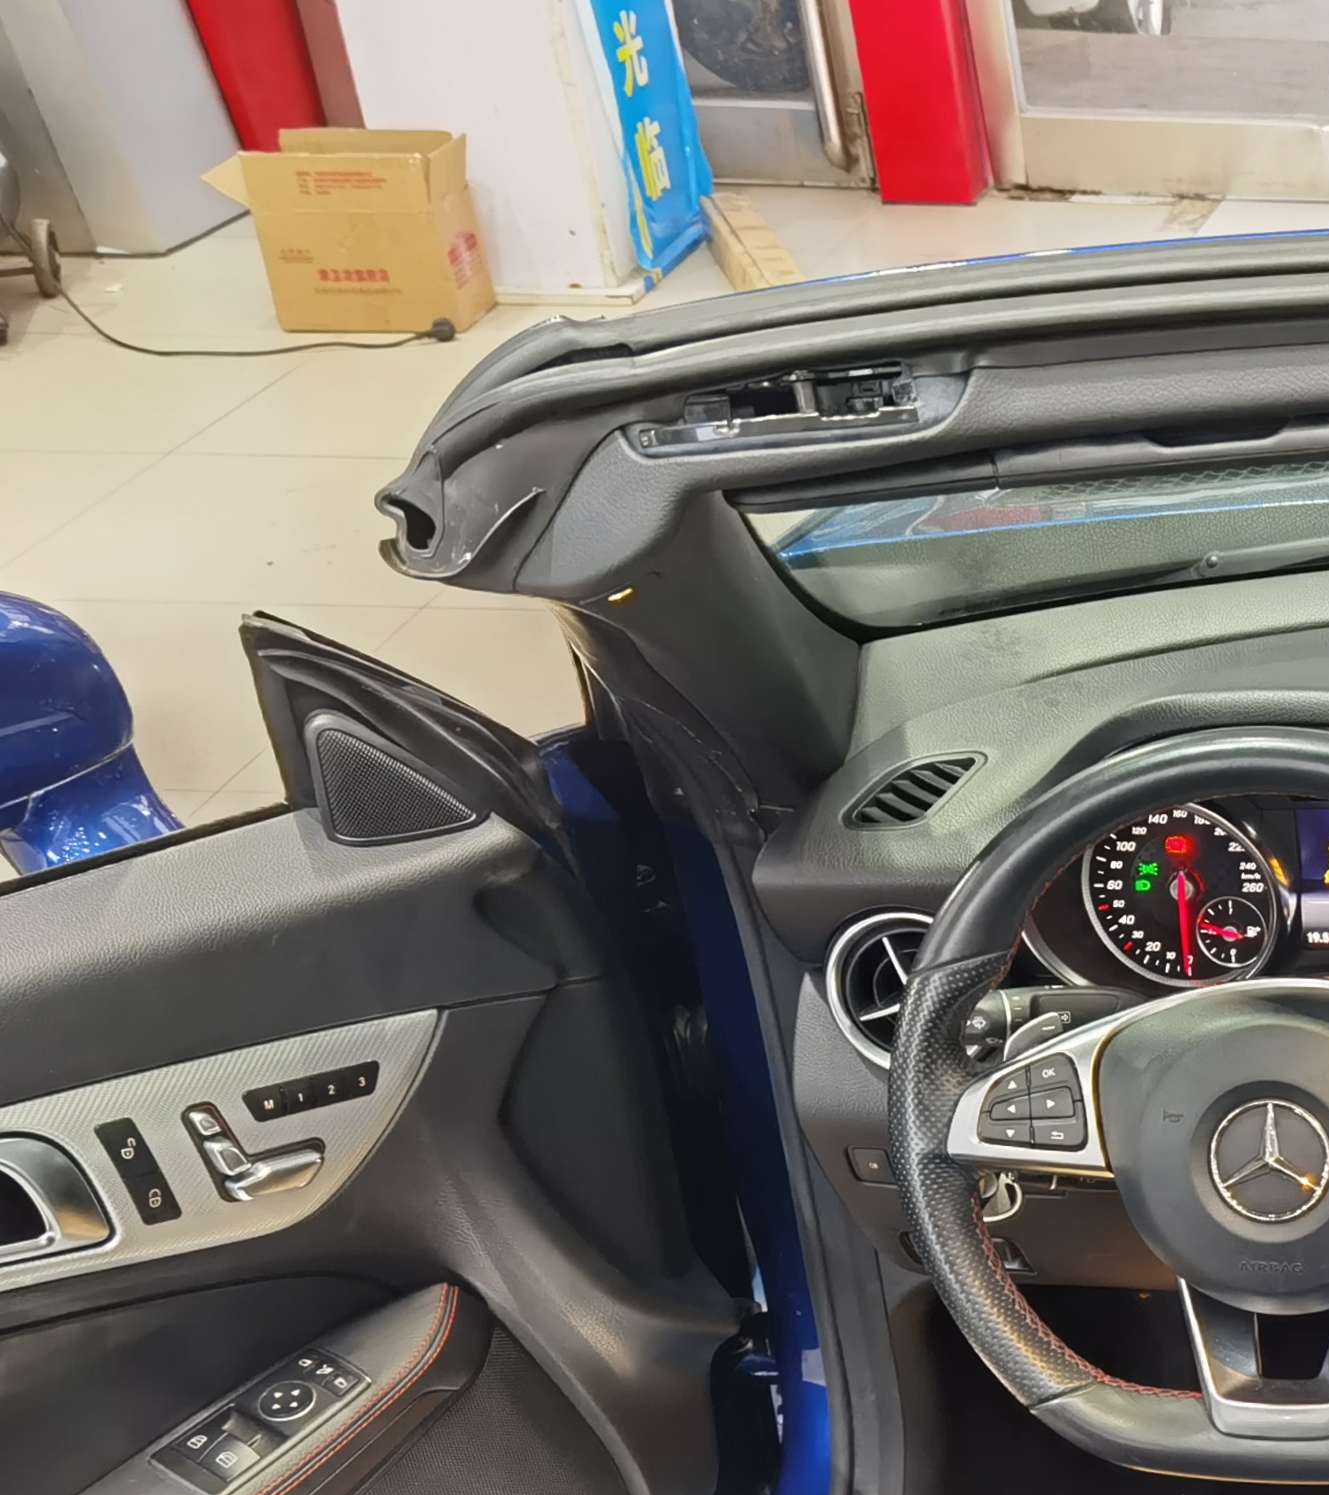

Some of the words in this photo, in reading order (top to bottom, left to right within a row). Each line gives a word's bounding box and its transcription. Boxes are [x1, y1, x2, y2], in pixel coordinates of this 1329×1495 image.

[612, 9, 672, 201] 光临
[1115, 841, 1136, 852] 100
[1227, 841, 1246, 853] 22
[1110, 860, 1123, 870] 80
[1239, 861, 1257, 871] 240
[1106, 880, 1123, 891] 60
[1241, 882, 1265, 893] 260
[1113, 899, 1125, 909] 50
[1118, 915, 1135, 926] 40
[1131, 930, 1145, 940] 30
[1145, 941, 1162, 952] 20
[1042, 1067, 1056, 1079] OK
[263, 1099, 275, 1110] M
[297, 1092, 304, 1103] 1
[327, 1084, 336, 1096] 2
[358, 1076, 366, 1087] 3
[1240, 1260, 1305, 1273] AIRBAG
